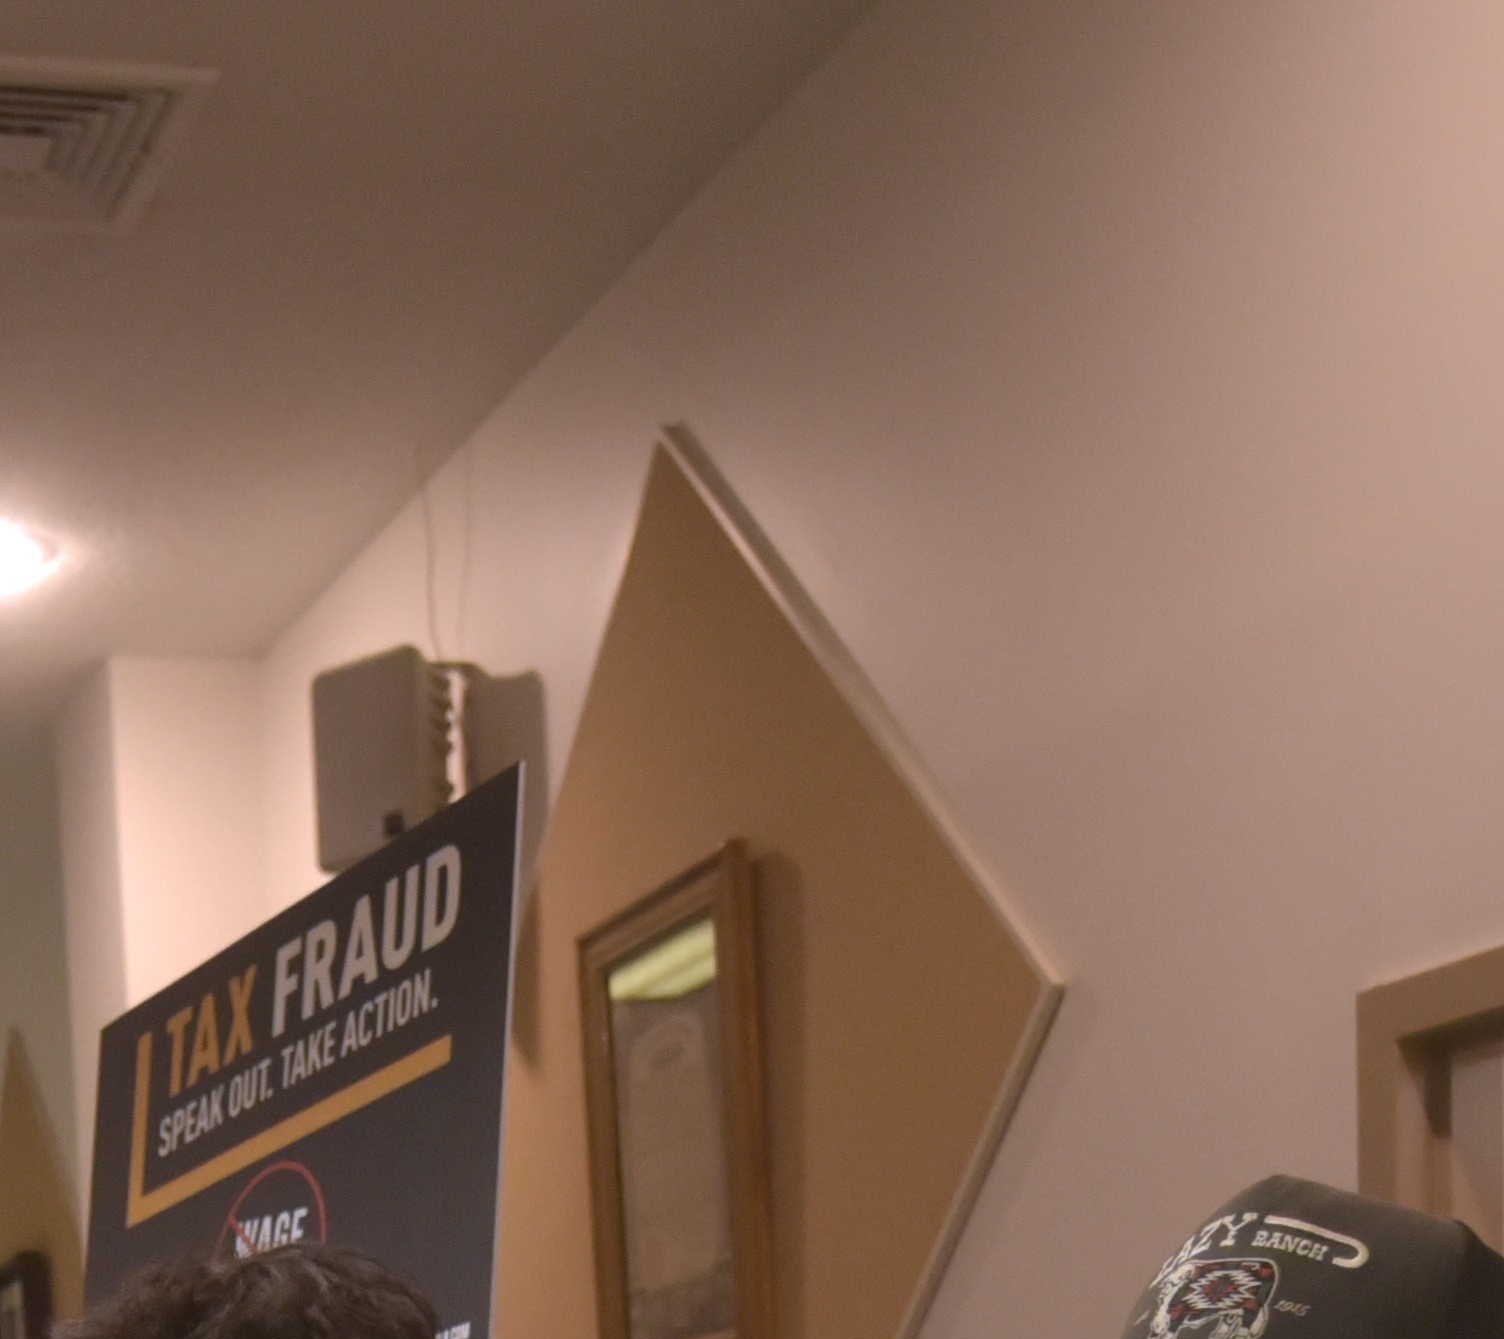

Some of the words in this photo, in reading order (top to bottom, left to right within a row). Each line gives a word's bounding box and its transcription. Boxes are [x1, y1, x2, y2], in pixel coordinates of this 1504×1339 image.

[158, 1084, 225, 1159] SPEAK
[228, 1058, 273, 1118] OUT.
[281, 1021, 337, 1090] TAKE
[340, 967, 439, 1058] ACTION.
[166, 964, 257, 1099] TAX
[272, 843, 461, 1039] FRAUD
[1251, 1230, 1330, 1262] RANCH
